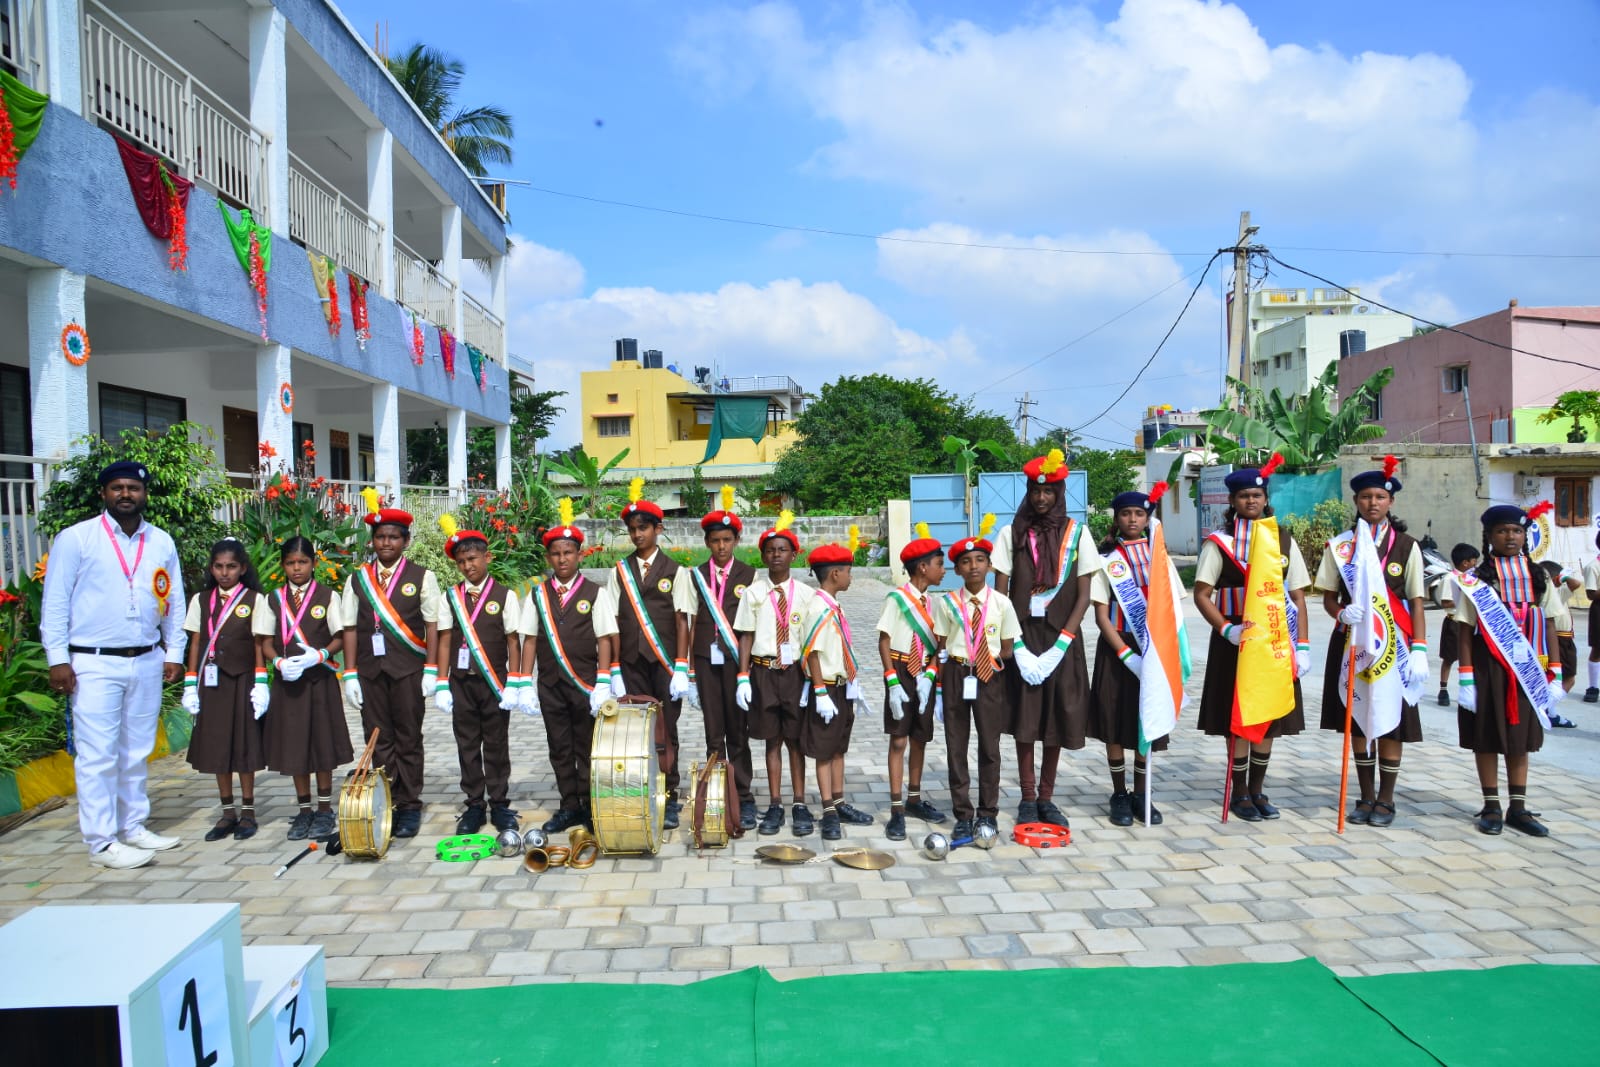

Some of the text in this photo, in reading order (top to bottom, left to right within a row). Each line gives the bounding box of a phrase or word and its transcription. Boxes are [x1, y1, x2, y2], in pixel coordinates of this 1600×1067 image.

[1116, 577, 1138, 603] BRAND
[1472, 585, 1497, 615] BRAND
[1372, 603, 1396, 676] AMBASSADOR
[178, 978, 218, 1067] 1
[284, 995, 307, 1067] 3
